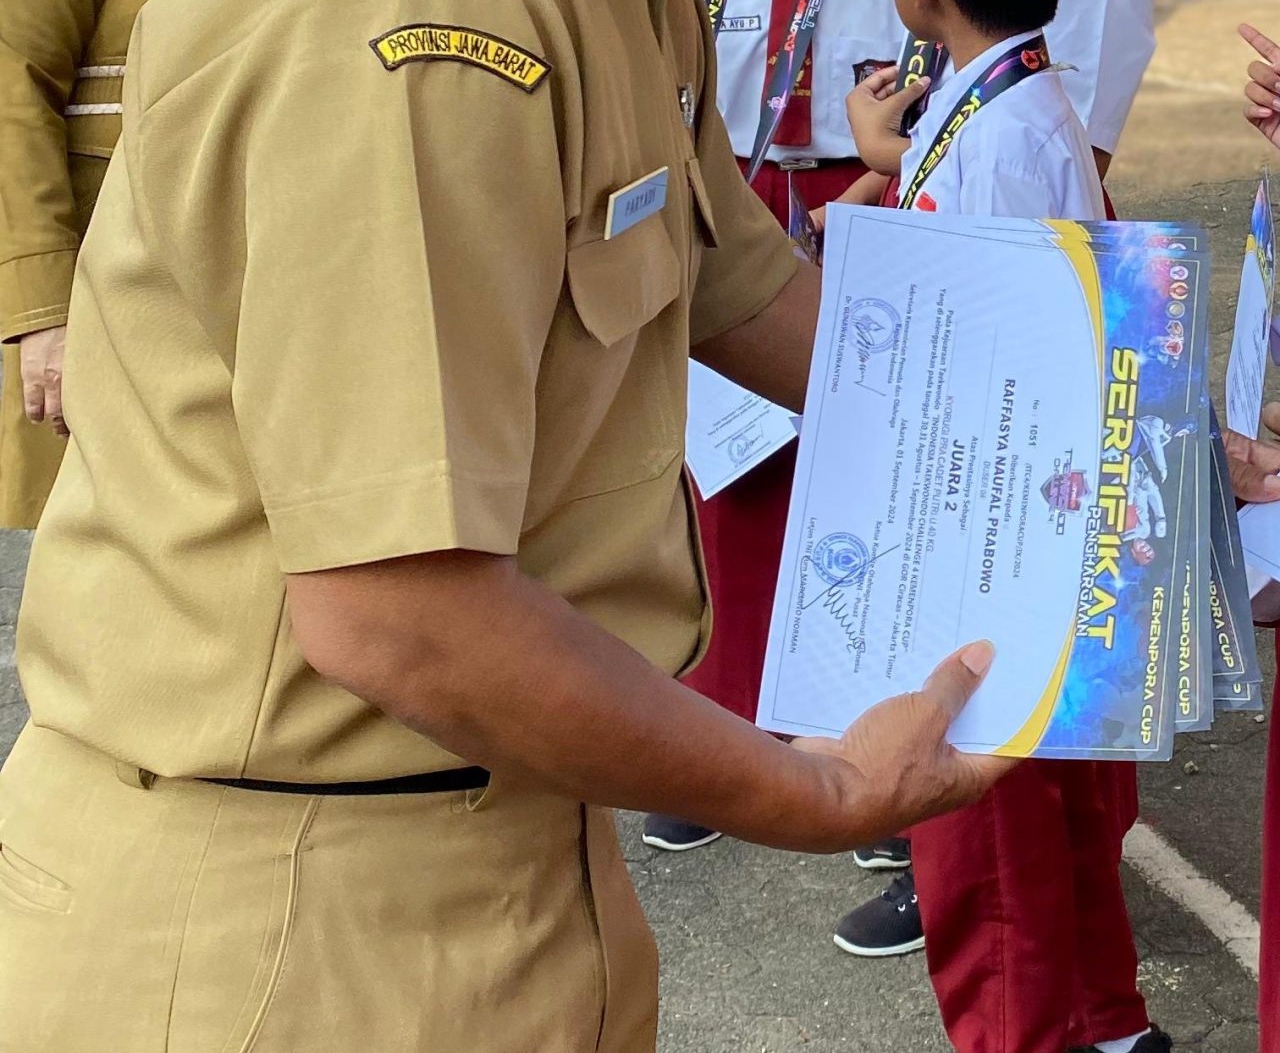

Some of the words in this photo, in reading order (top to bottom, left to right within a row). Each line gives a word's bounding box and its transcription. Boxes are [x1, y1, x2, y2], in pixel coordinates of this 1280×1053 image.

[730, 19, 744, 29] AYU
[749, 19, 755, 28] P
[388, 30, 451, 58] PROVINSI
[454, 33, 490, 62] JAWA
[493, 45, 537, 80] BARAT
[935, 287, 946, 306] Yang
[935, 306, 944, 316] di
[838, 305, 850, 343] GUNAWAN
[944, 309, 954, 328] Pada
[928, 316, 942, 369] selenggarakan
[939, 328, 951, 365] Kejuaraan
[830, 343, 844, 393] SUSWANTORO
[925, 369, 934, 389] pada
[893, 383, 902, 398] dan
[920, 389, 932, 419] tanggal
[933, 367, 946, 410] Taekwondo
[940, 394, 954, 436] KYORUGI
[996, 378, 1016, 451] RAFFASYA
[896, 417, 908, 447] Jakarta,
[938, 436, 949, 455] PRA
[969, 435, 978, 453] Atas
[1027, 423, 1038, 446] 1051
[895, 449, 904, 459] 01
[914, 442, 925, 474] Agustus
[945, 438, 965, 495] JUARA
[889, 460, 902, 503] September
[933, 455, 946, 487] CADET
[962, 453, 976, 498] Prestasinya
[988, 455, 1006, 512] NAUFAL
[1007, 453, 1019, 491] Diberikan
[918, 463, 933, 516] TAEKWONDO
[1083, 345, 1141, 649] SERTIFIKAT
[886, 504, 896, 524] 2024
[906, 487, 919, 530] September
[943, 500, 957, 512] 2
[958, 499, 970, 531] Sebagai
[1003, 492, 1014, 522] Kepada
[872, 520, 882, 541] Ketua
[903, 531, 913, 552] 2024
[912, 517, 926, 565] CHALLENGE
[924, 537, 934, 552] KG
[926, 525, 936, 537] 40
[804, 540, 813, 554] TNI
[902, 552, 911, 561] di
[978, 517, 998, 593] PRABOWO
[862, 568, 875, 603] Olahraga
[899, 562, 909, 582] GOR
[1074, 505, 1101, 637] PENGHARGAAN
[851, 596, 862, 618] Pusat
[894, 582, 906, 613] Ciracas
[903, 573, 918, 628] KEMENPORA
[788, 616, 800, 653] NORMAN
[858, 603, 870, 636] Nasional
[888, 620, 900, 652] Jakarta
[1142, 586, 1164, 701] KEMENPORA
[1218, 634, 1235, 669] CUP
[885, 653, 896, 679] Timur
[1178, 676, 1191, 716] CUP
[1138, 704, 1154, 744] CUP
